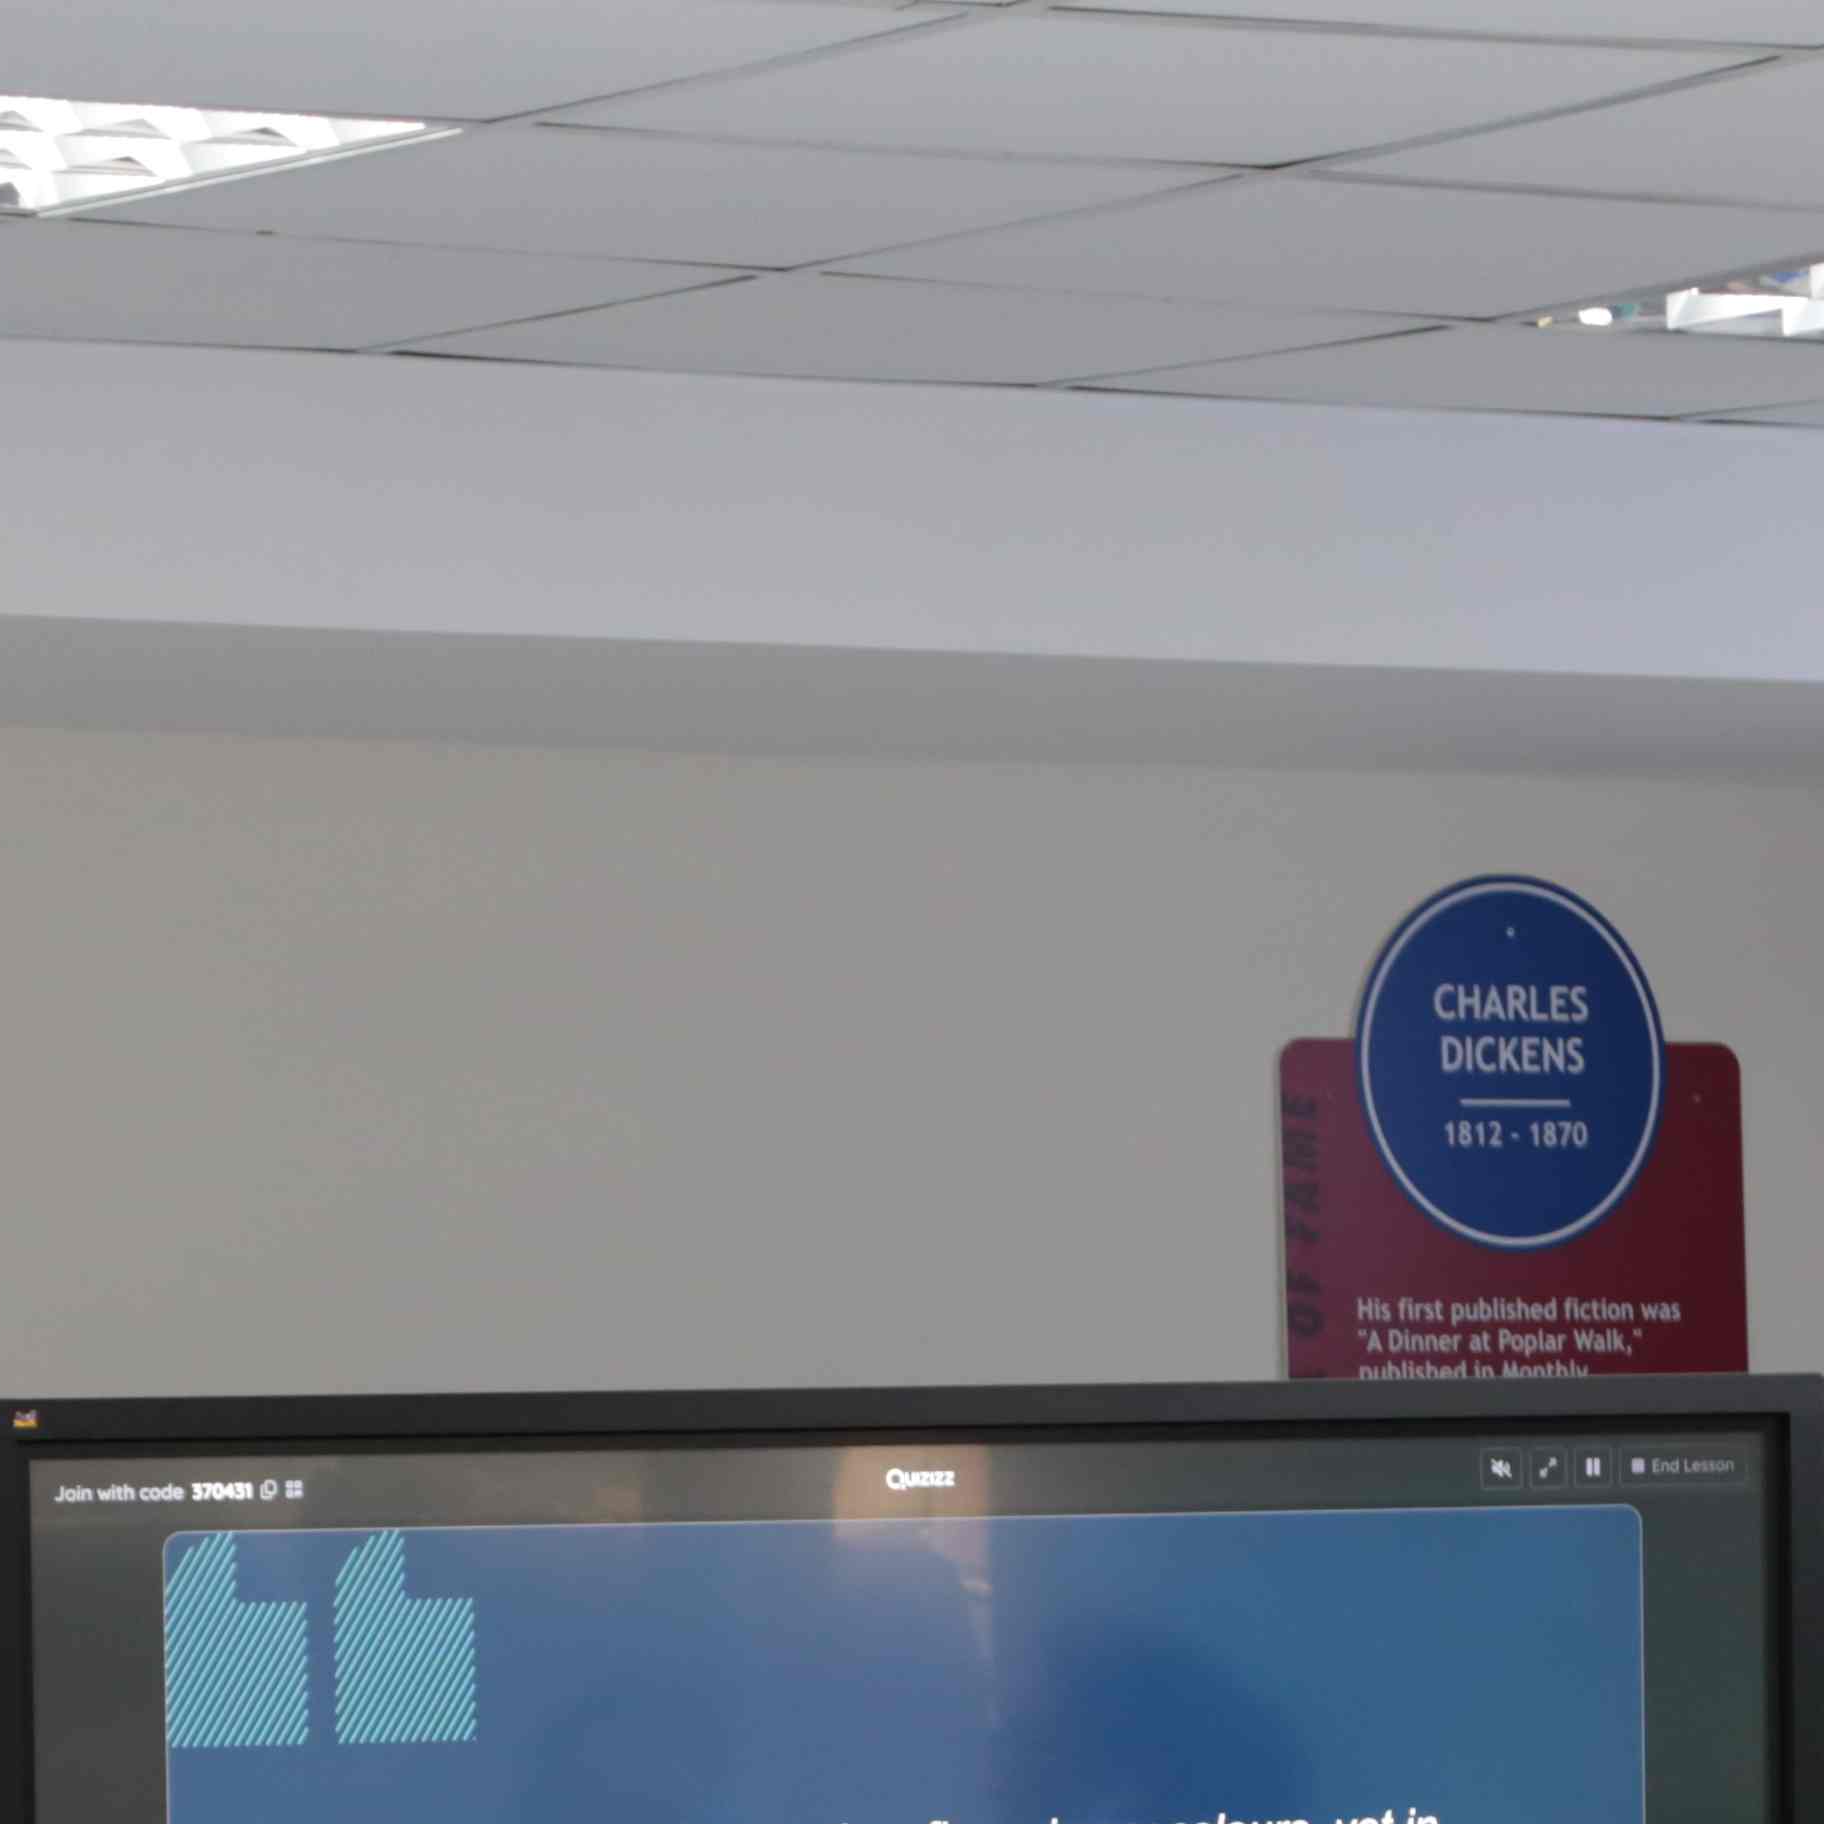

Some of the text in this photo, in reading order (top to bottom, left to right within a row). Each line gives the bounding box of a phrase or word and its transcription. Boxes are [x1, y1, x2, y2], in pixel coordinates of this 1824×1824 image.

[1433, 983, 1590, 1023] CHARLES
[1440, 1036, 1586, 1075] DICKENS
[1444, 1121, 1503, 1148] 1812
[1530, 1121, 1588, 1148] 1870
[1357, 1297, 1681, 1326] His first published fiction was
[1389, 1329, 1461, 1353] Dinner
[1469, 1331, 1491, 1353] at
[1498, 1329, 1567, 1357] Poplar
[1651, 1454, 1735, 1475] End Lesson
[54, 1480, 254, 1503] Join with code 370431
